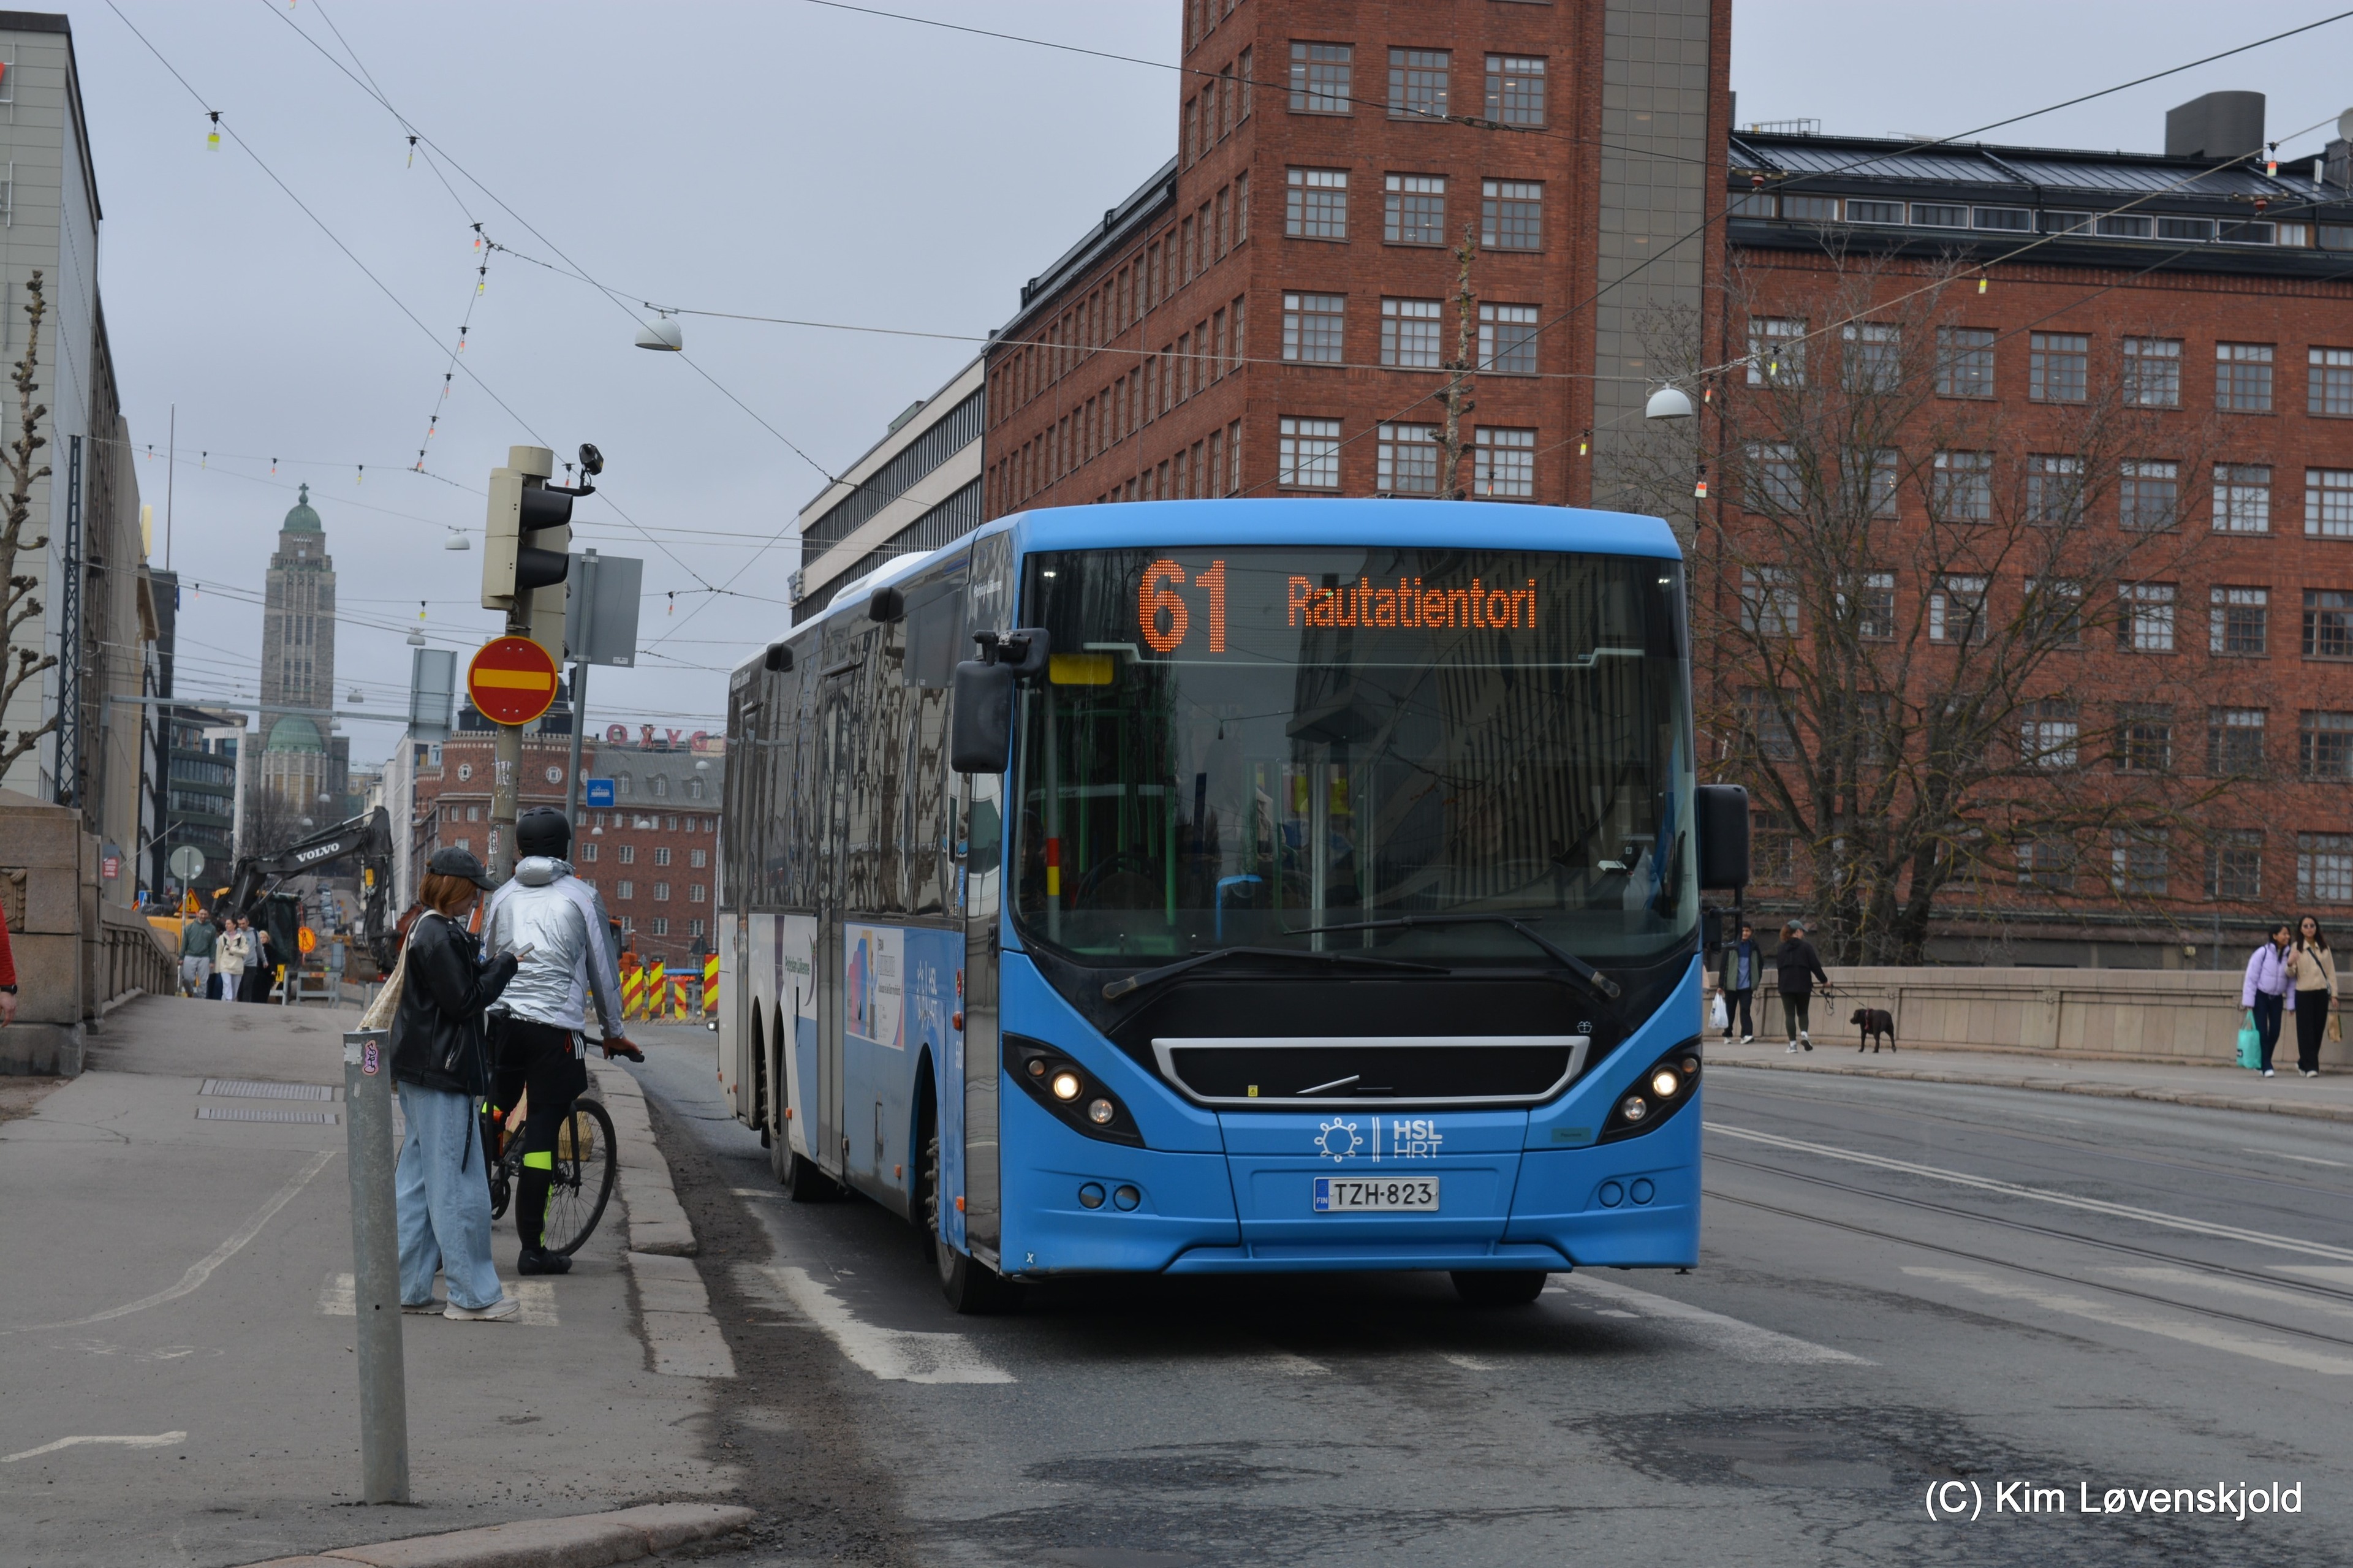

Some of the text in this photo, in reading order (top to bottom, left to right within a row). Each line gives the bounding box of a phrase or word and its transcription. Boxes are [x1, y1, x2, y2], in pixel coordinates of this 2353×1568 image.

[1139, 559, 1224, 652] 61
[1289, 576, 1535, 628] Rautatientori
[607, 724, 727, 752] OXYG
[296, 843, 339, 862] VOLVO
[1393, 1120, 1442, 1140] HSL
[1394, 1141, 1442, 1159] HRT
[1334, 1183, 1432, 1205] TZH-823
